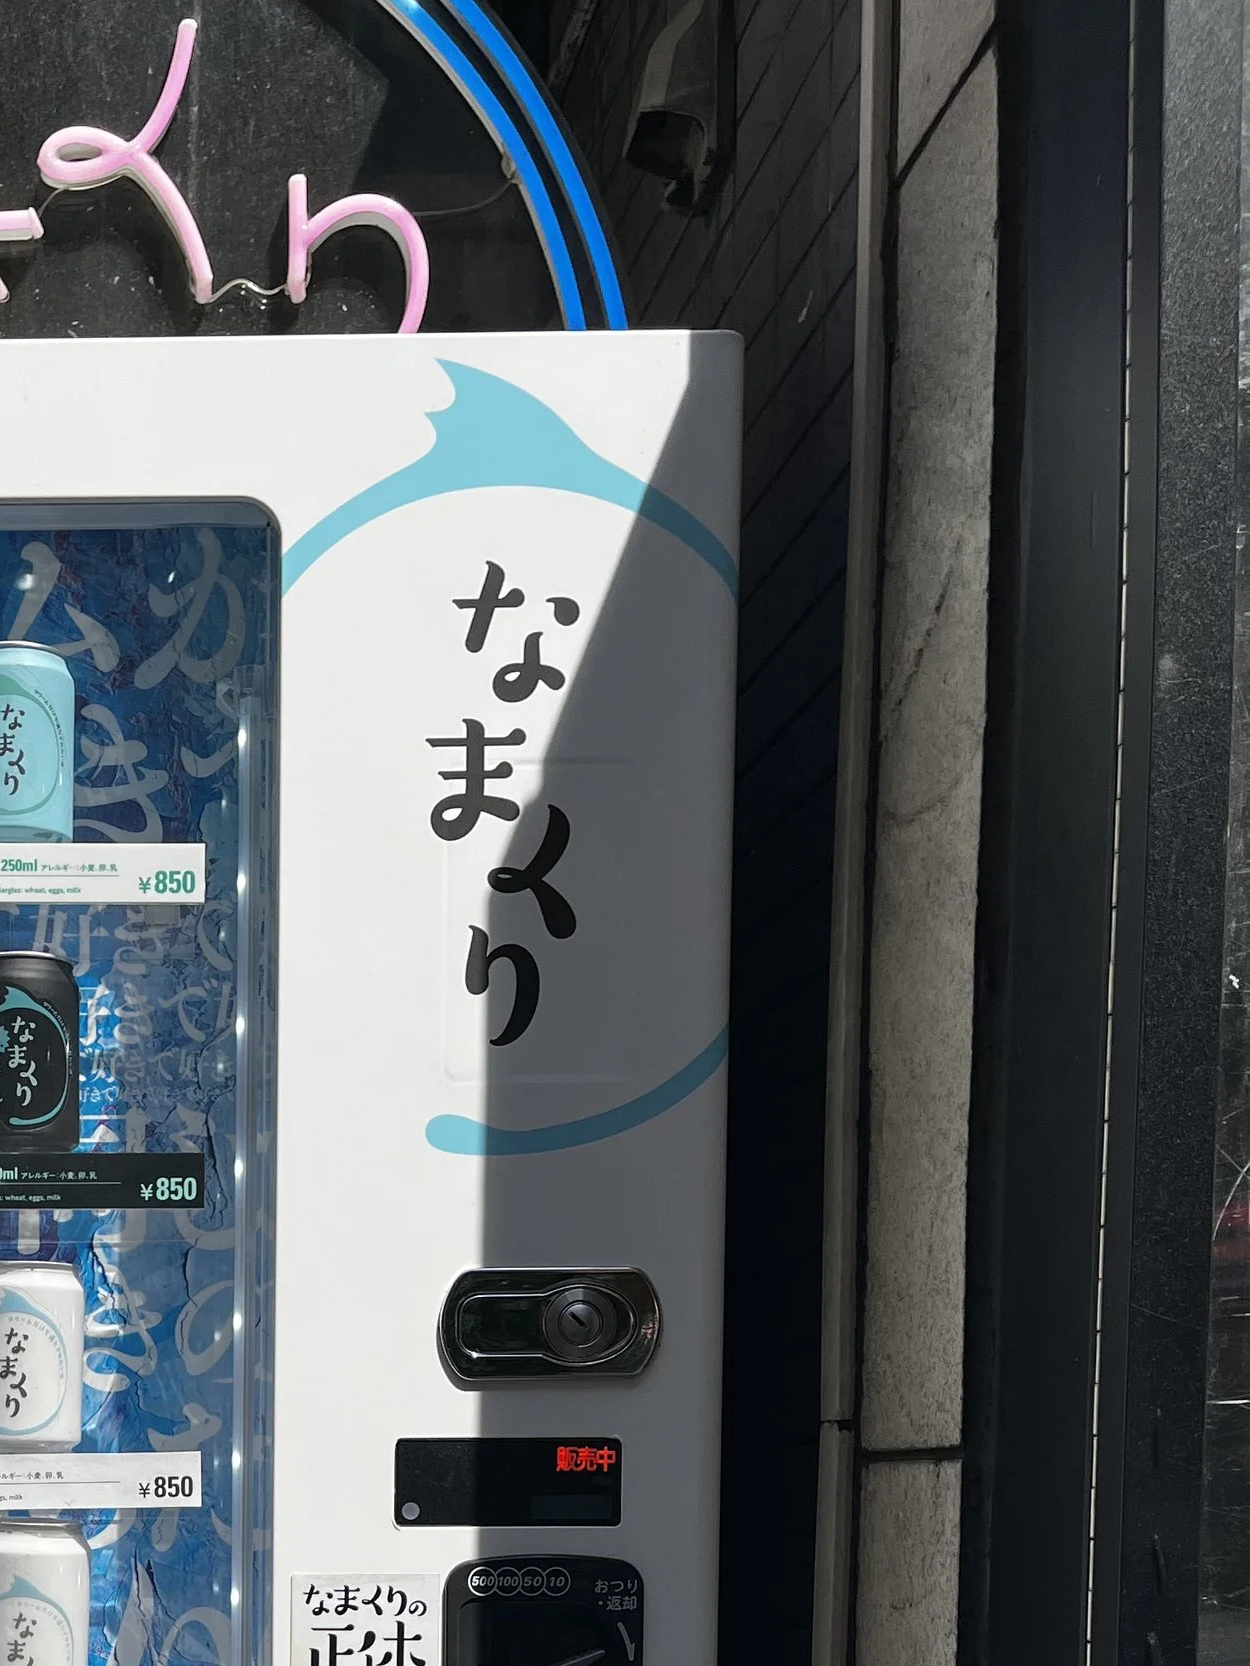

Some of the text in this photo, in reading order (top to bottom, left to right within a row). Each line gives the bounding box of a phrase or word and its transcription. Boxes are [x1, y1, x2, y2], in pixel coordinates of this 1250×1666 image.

[426, 560, 581, 1047] なまくり
[1, 859, 38, 872] 250ml
[138, 870, 196, 894] ¥850
[7, 1016, 38, 1107] なまくり
[140, 1177, 197, 1201] ¥850
[0, 1327, 28, 1418] なまくり
[556, 1447, 616, 1471] 販売中
[138, 1476, 193, 1499] ¥850
[471, 1575, 565, 1587] 500 100 50 10
[594, 1579, 638, 1594] おつり
[303, 1584, 427, 1617] なまくりの
